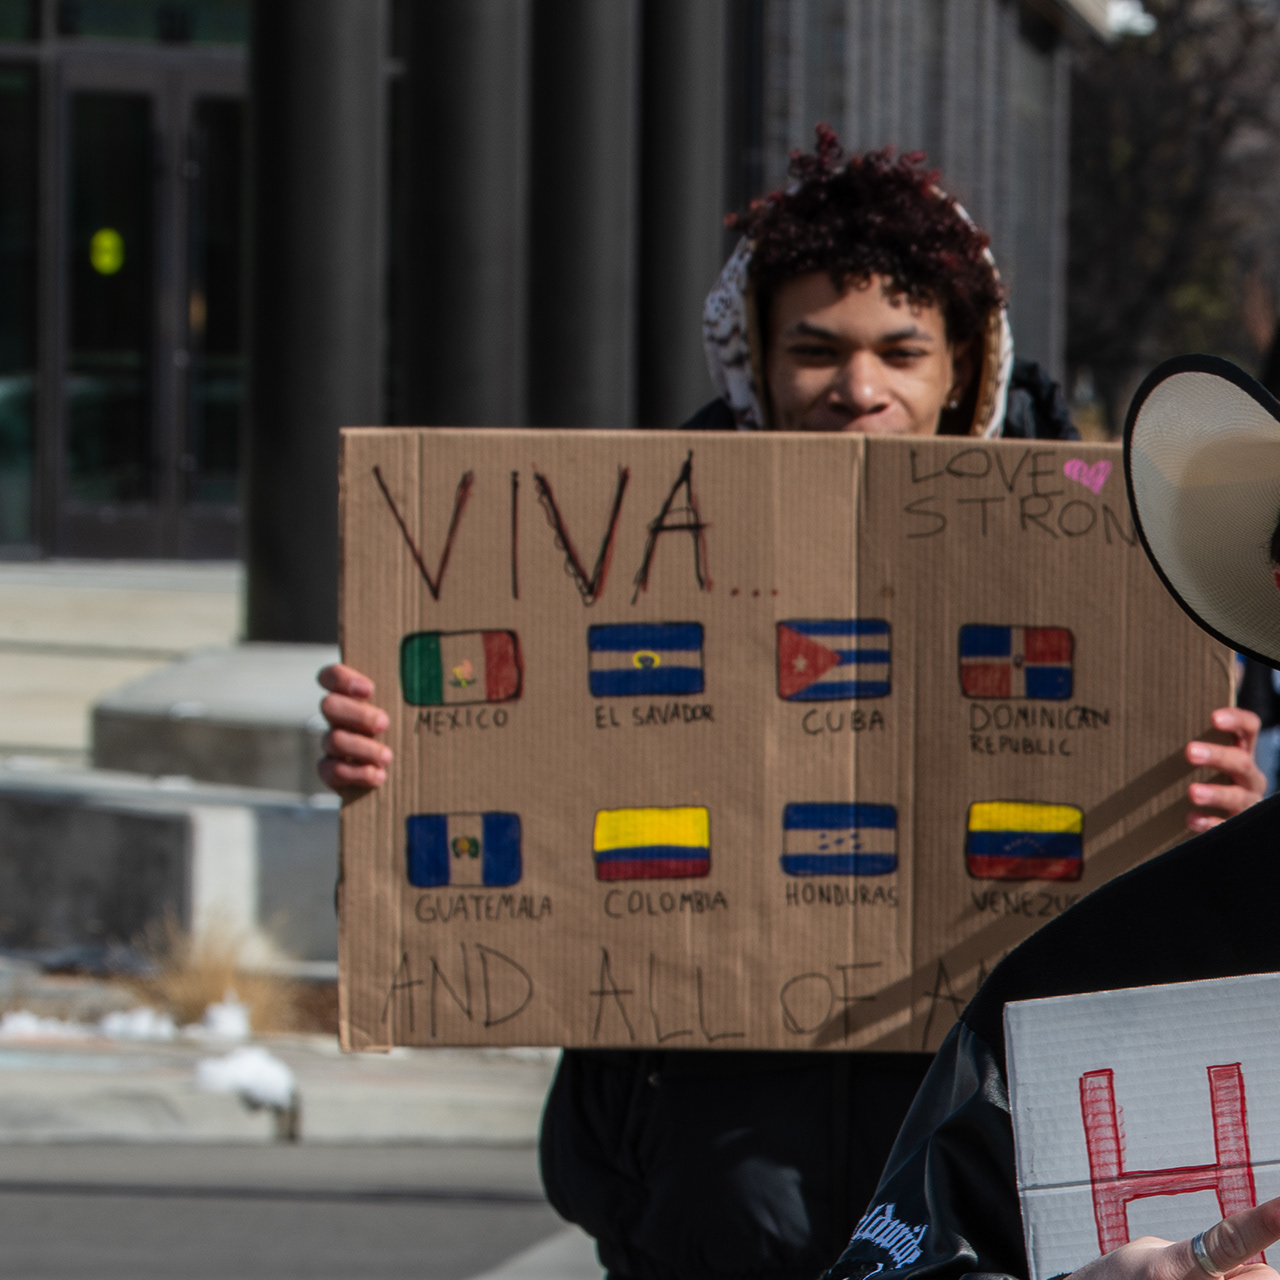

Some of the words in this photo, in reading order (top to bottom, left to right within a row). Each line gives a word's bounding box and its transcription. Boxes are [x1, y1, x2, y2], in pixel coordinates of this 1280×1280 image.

[910, 447, 1064, 498] LOVE
[903, 495, 1138, 547] STRON
[415, 707, 509, 735] MEXICO
[595, 705, 625, 728] EL
[802, 707, 886, 735] CUBA
[970, 704, 1111, 731] DOMINICAN
[970, 733, 1074, 758] REPUBLIC
[415, 892, 553, 924] GUATEMALA
[604, 889, 728, 920] COLOMBIA
[786, 881, 900, 910] HONDURAS
[971, 890, 1079, 918] VENEZU
[381, 942, 534, 1038] AND
[588, 946, 746, 1044] ALL
[779, 961, 884, 1036] OF
